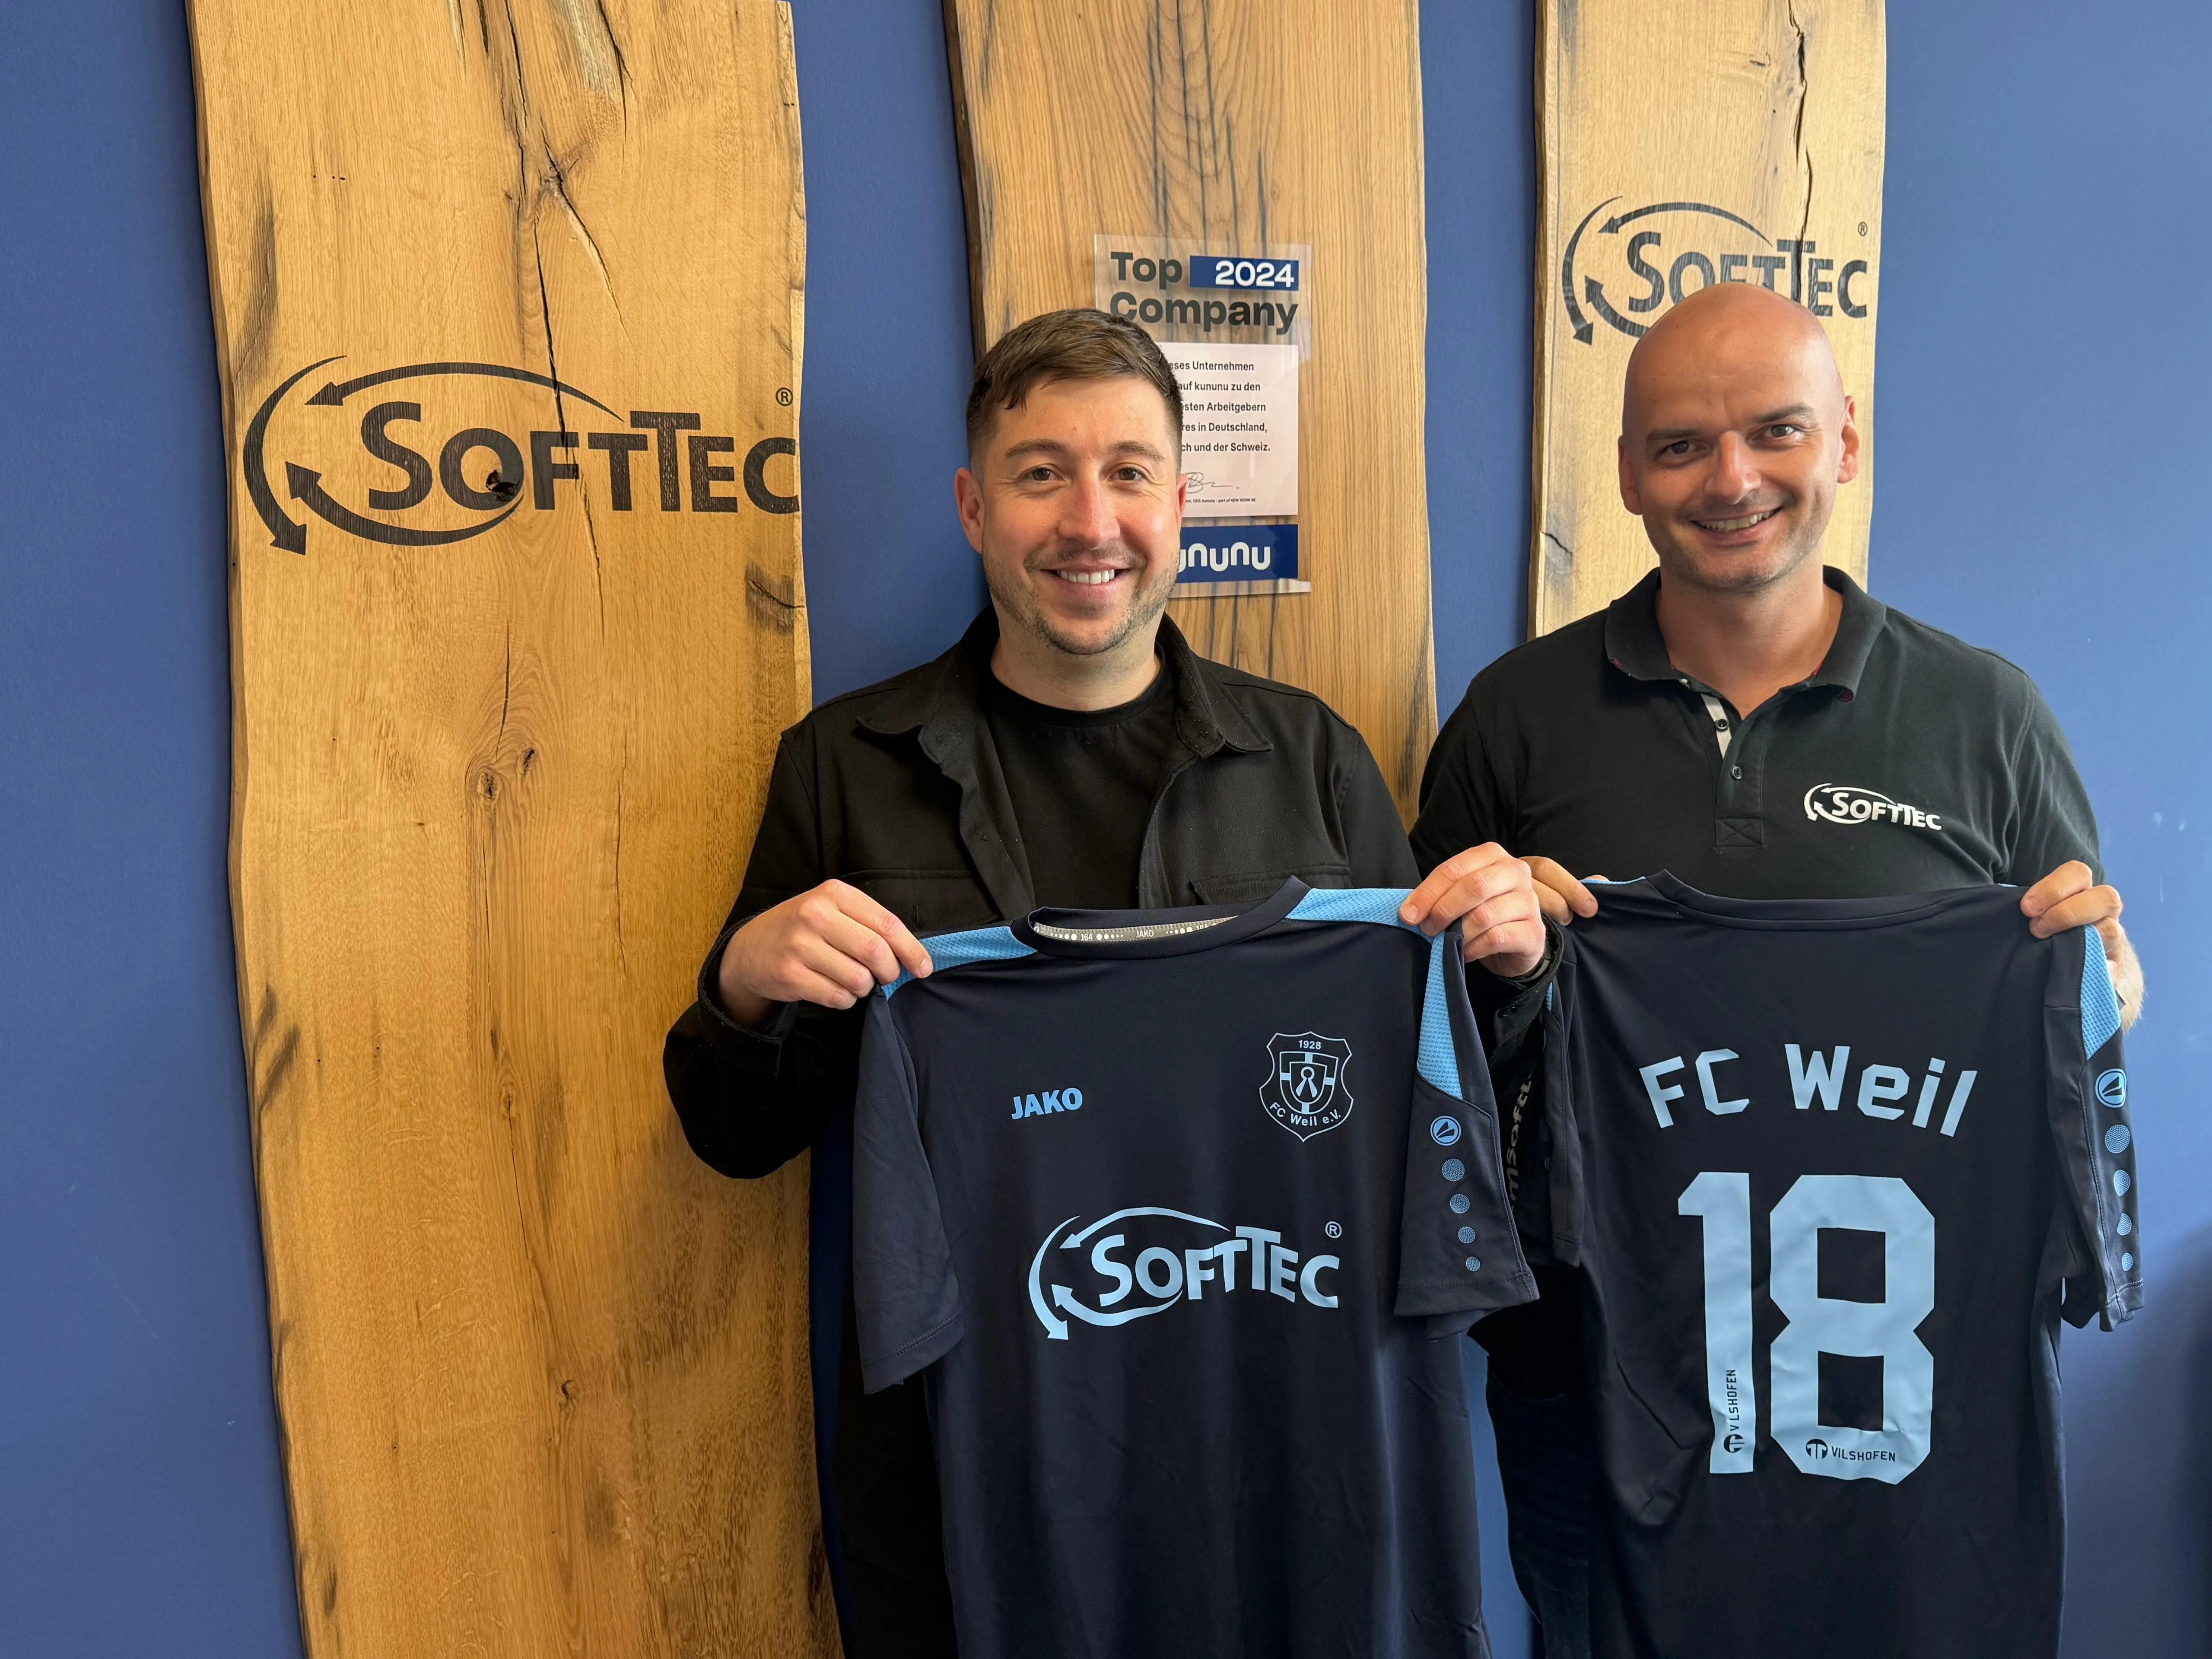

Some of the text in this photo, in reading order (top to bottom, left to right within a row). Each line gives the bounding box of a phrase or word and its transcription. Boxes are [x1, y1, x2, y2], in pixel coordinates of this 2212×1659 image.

[1111, 251, 1294, 290] Top 2024
[1110, 292, 1298, 335] Company
[1192, 361, 1254, 371] Unternehmen
[1178, 381, 1192, 390] auf
[1195, 381, 1228, 391] kununu
[1244, 382, 1261, 391] den
[1182, 402, 1266, 413] sten Arbeitgebern
[1198, 422, 1206, 431] in
[1208, 422, 1267, 433] Deutschland,
[1194, 442, 1211, 451] und
[1214, 442, 1228, 451] der
[1230, 442, 1271, 451] Schweiz.
[1136, 929, 1154, 938] JAKO
[1298, 1039, 1322, 1050] 1928
[1639, 1043, 1978, 1137] FC Weil
[1011, 1087, 1083, 1120] JAKO
[1269, 1102, 1341, 1126] FC Weil e.V.
[1678, 1171, 1935, 1485] 18
[1726, 1369, 1740, 1431] VLSHOFEN
[1831, 1446, 1896, 1462] VILSHOFEN
